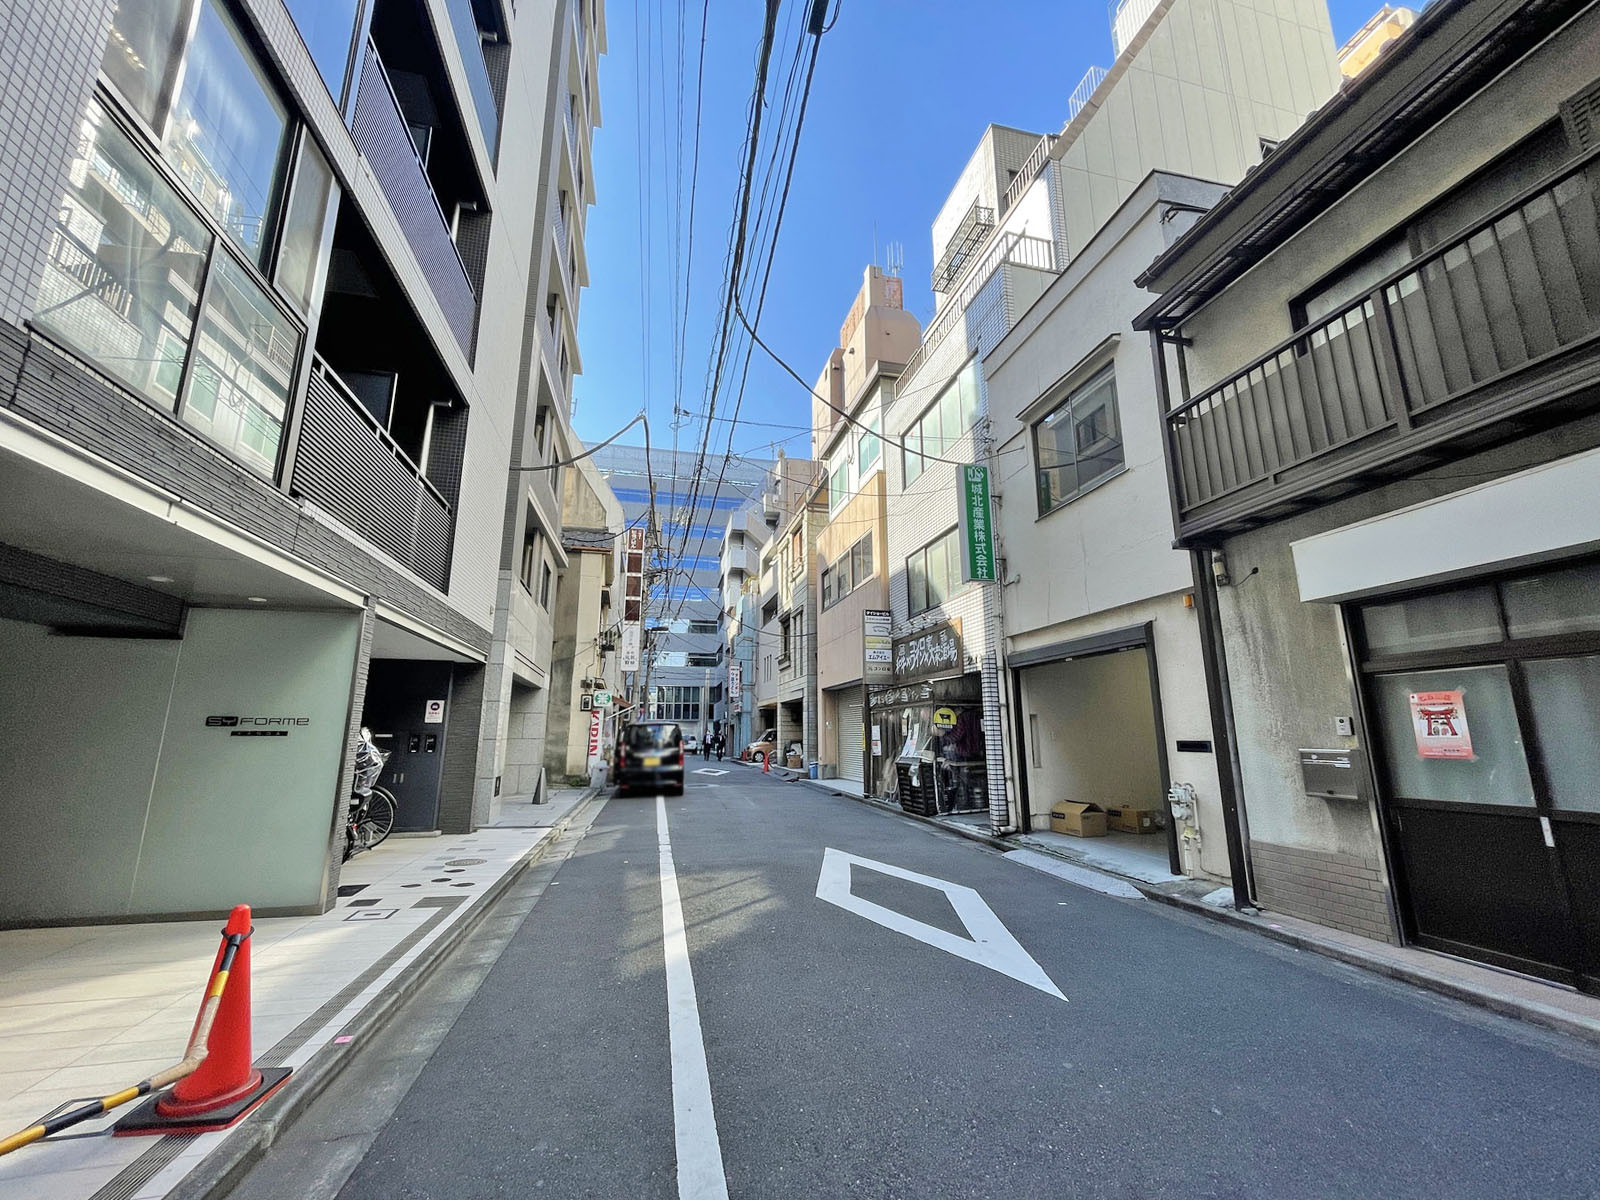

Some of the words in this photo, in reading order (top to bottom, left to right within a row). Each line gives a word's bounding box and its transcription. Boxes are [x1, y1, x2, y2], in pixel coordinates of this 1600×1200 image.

[971, 483, 989, 579] 城北産業株式会社
